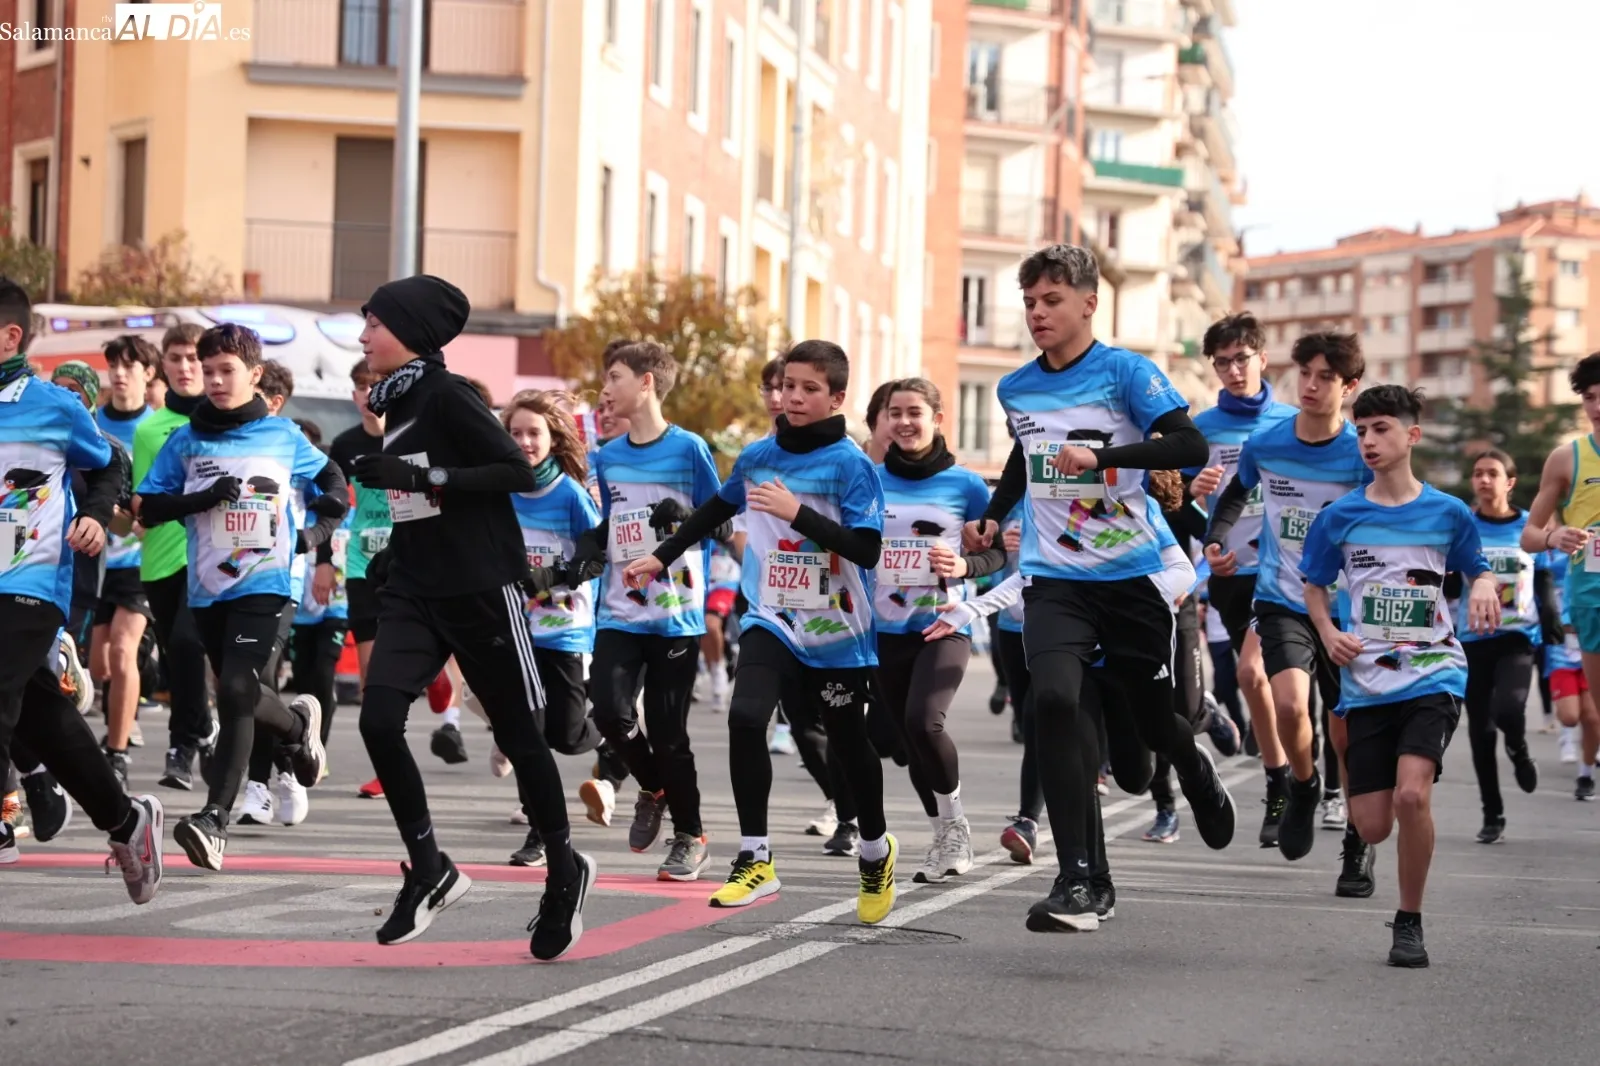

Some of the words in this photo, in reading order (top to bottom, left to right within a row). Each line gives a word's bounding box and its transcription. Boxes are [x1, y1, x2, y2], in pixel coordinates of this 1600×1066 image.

[229, 501, 271, 511] SETEL
[225, 511, 257, 531] 6117
[617, 510, 652, 522] SETEL
[616, 522, 642, 545] 6113
[891, 540, 933, 548] SETEL
[777, 554, 822, 565] SETEL
[884, 550, 922, 569] 6272
[769, 565, 810, 589] 6324
[1381, 588, 1428, 598] SETEL
[1373, 599, 1414, 622] 6162
